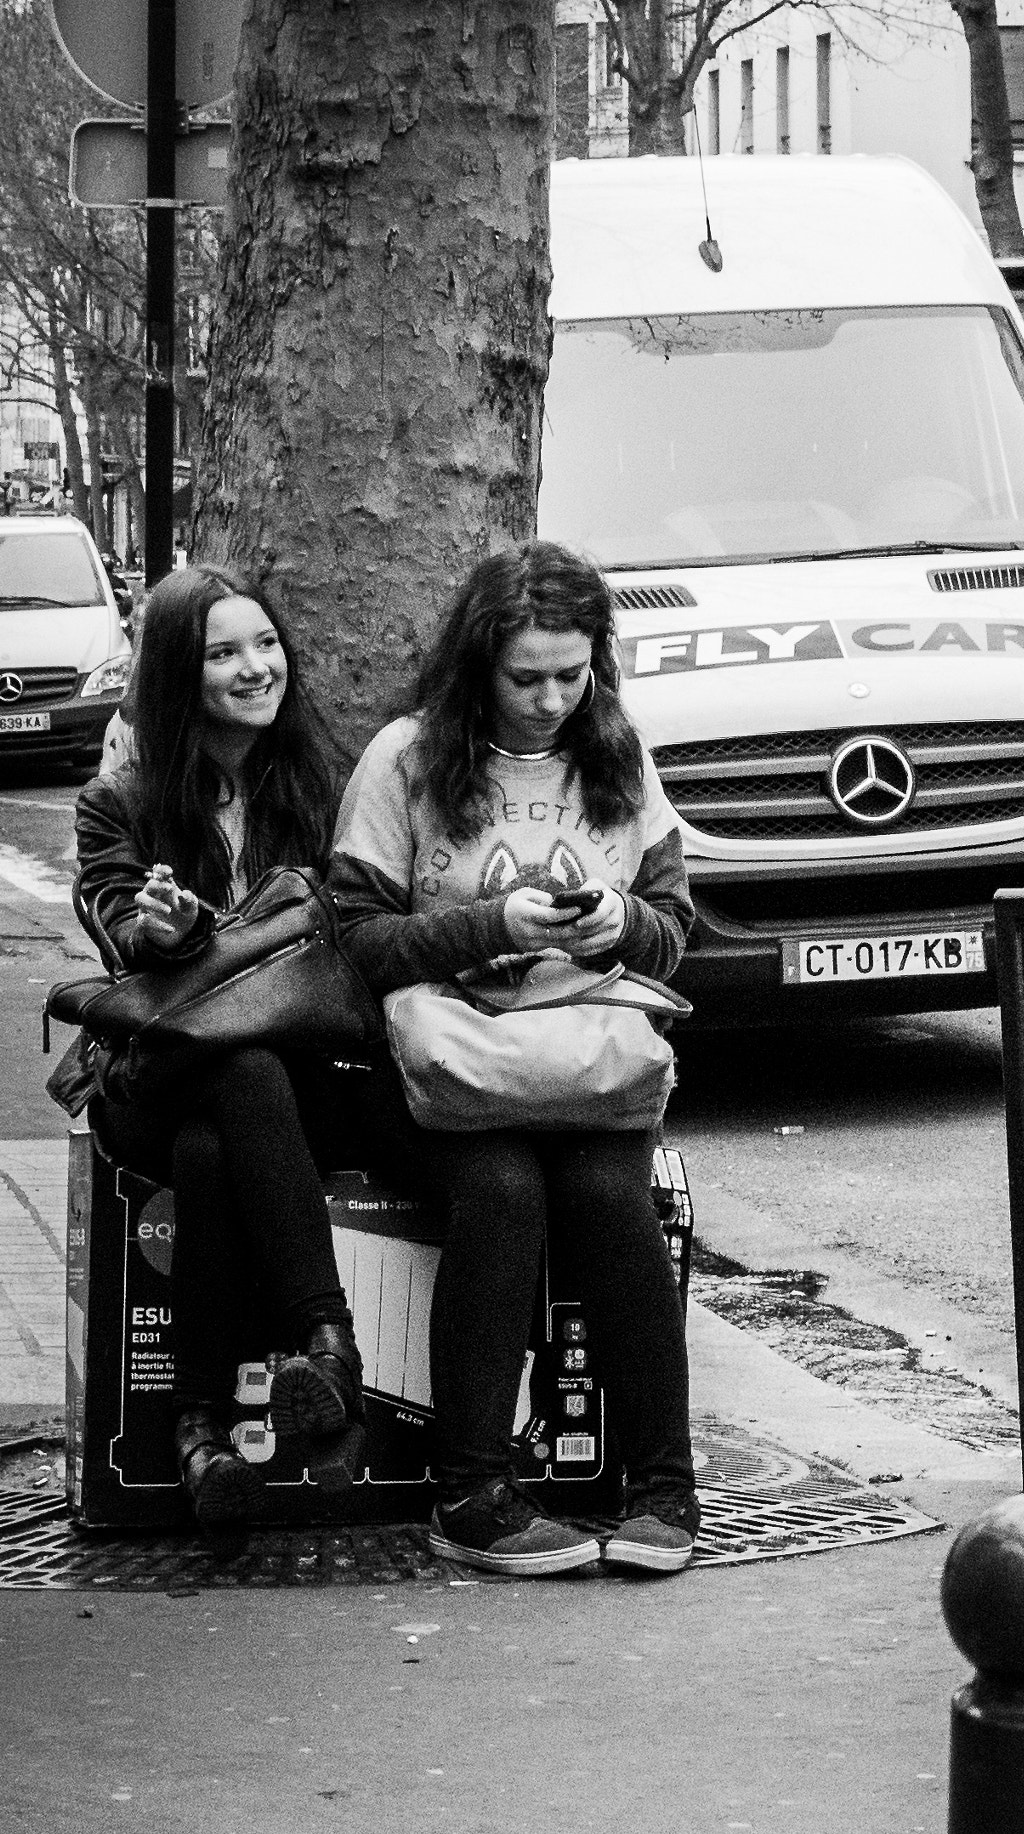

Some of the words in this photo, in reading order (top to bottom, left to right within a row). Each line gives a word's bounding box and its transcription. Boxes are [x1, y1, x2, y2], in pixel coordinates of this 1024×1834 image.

[633, 624, 821, 675] FLY
[348, 1200, 379, 1210] Classe
[138, 1222, 176, 1242] eq
[132, 1332, 160, 1343] ED31
[131, 1351, 170, 1360] Radiateur
[412, 1417, 425, 1427] cm
